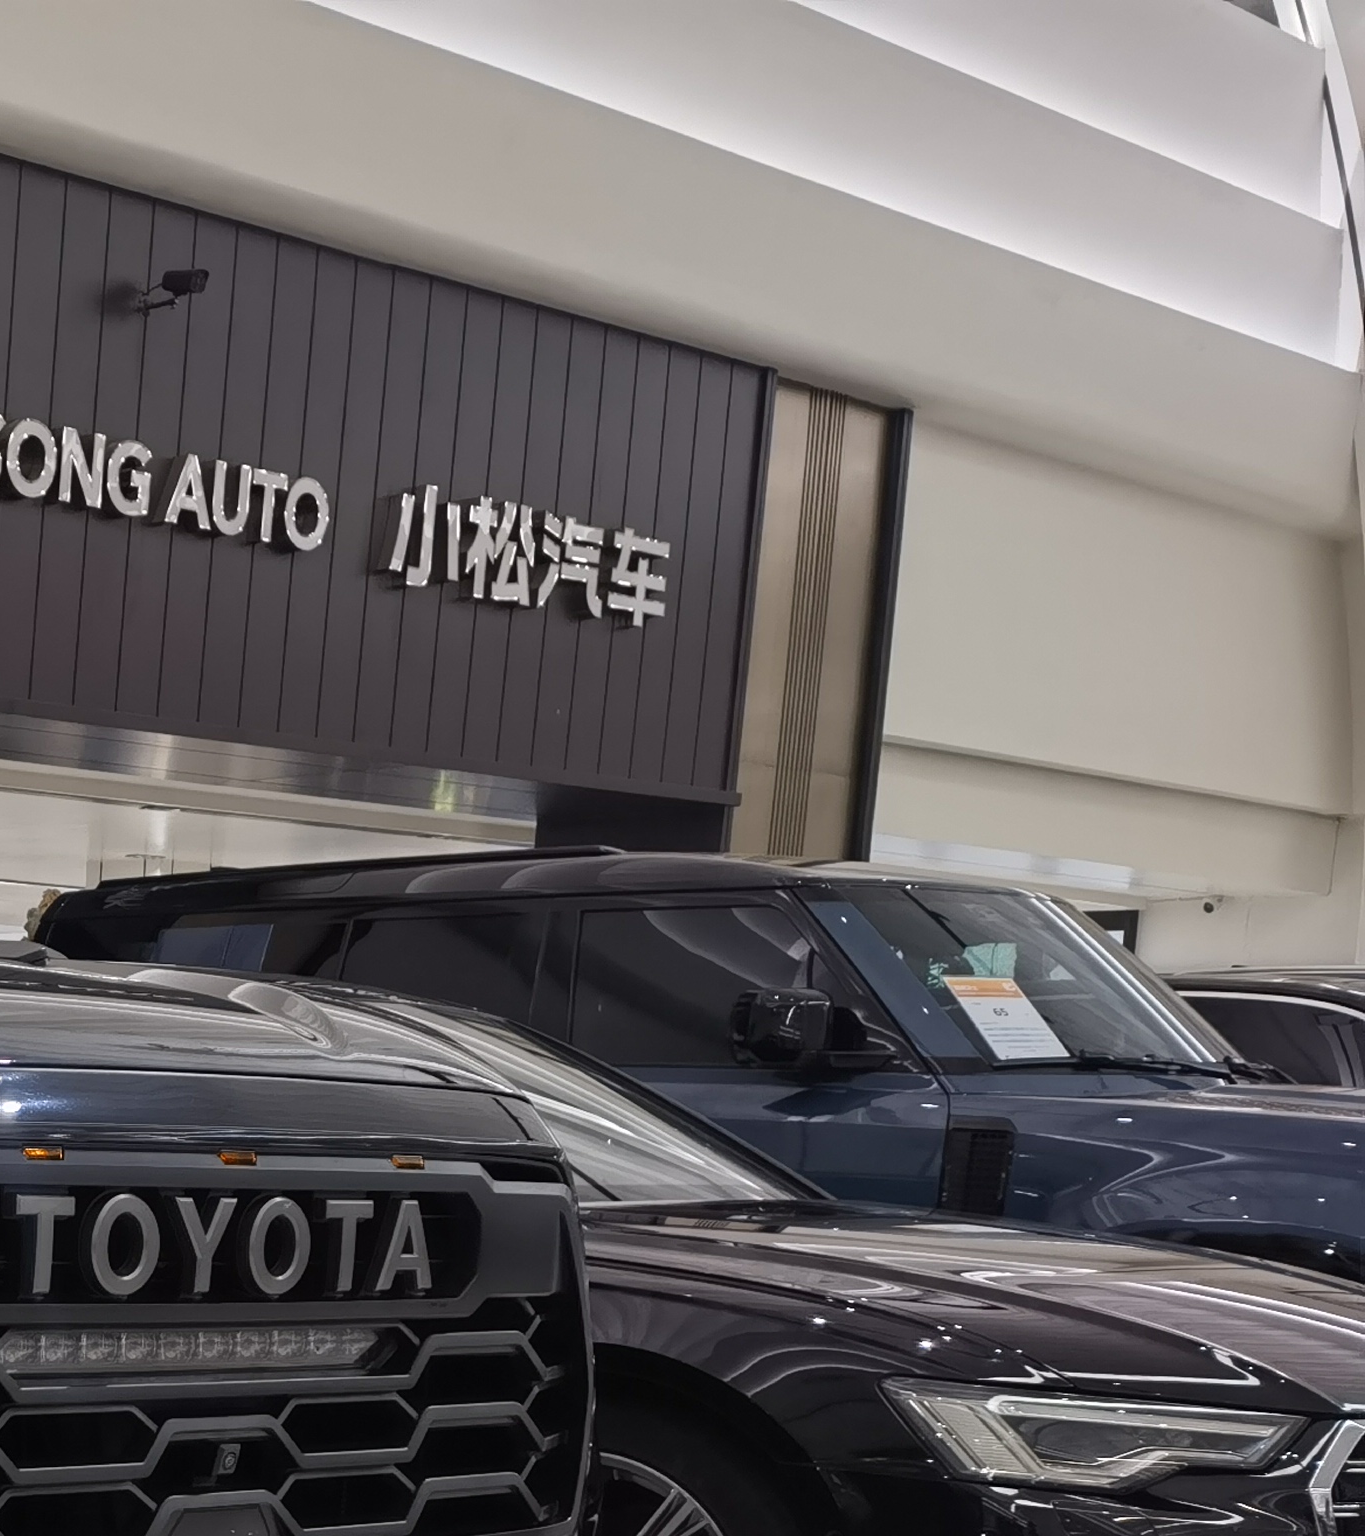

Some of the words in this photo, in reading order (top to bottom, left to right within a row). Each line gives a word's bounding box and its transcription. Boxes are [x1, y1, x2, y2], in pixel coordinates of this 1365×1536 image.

[161, 453, 331, 552] AUTO
[386, 484, 671, 628] 小松汽车
[992, 1007, 1009, 1017] 65
[15, 1192, 433, 1296] TOYOTA
